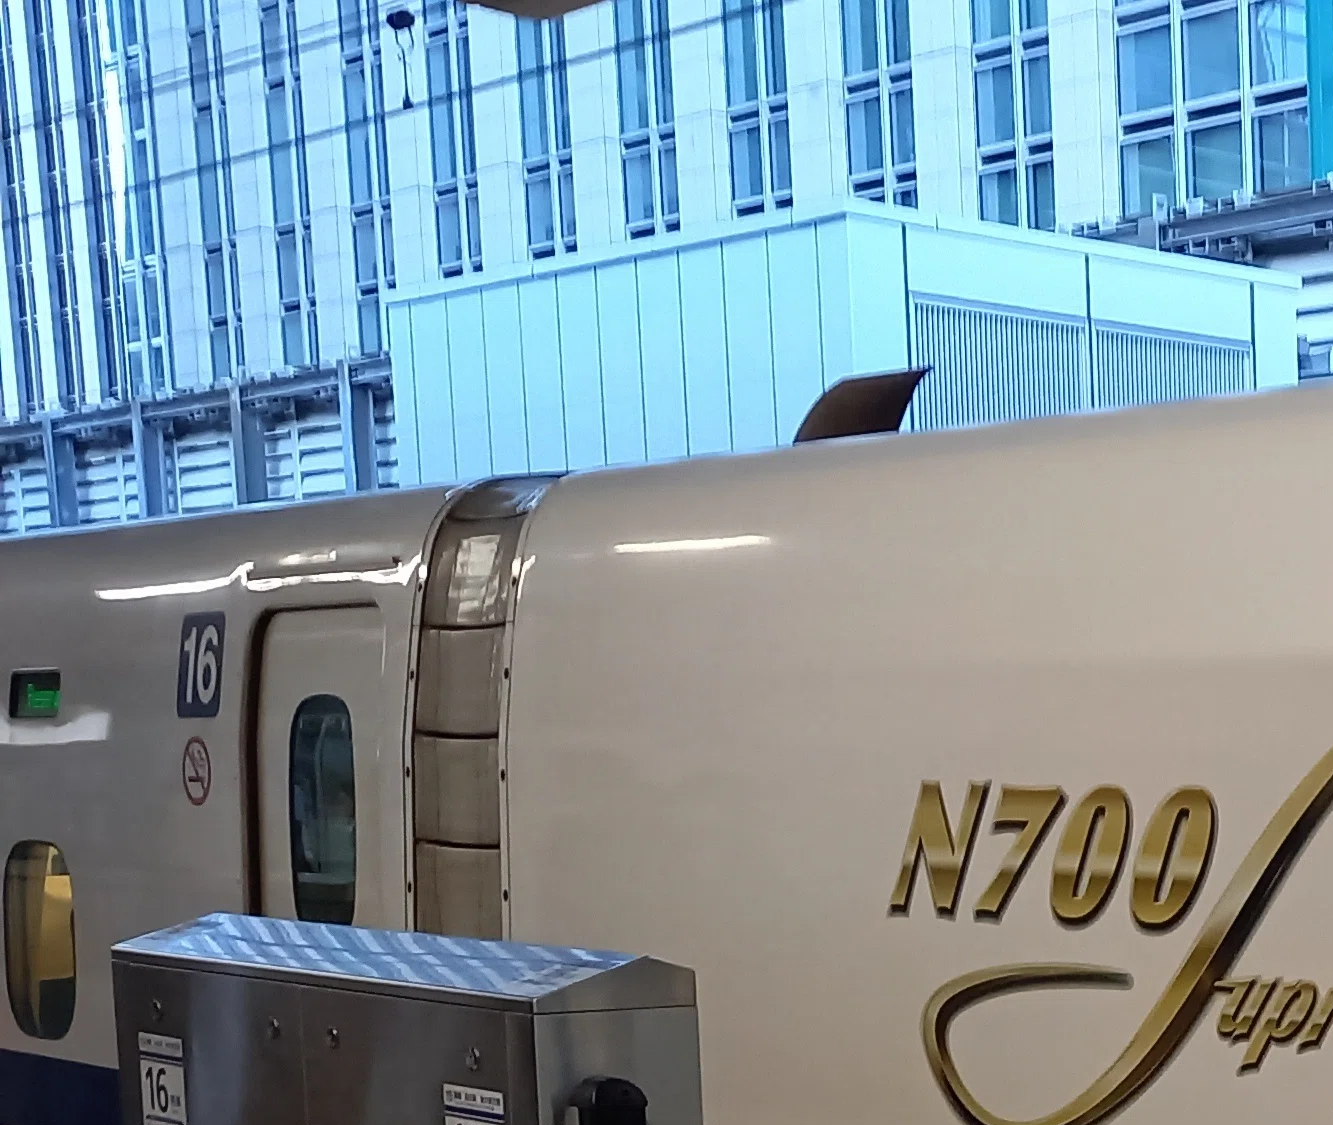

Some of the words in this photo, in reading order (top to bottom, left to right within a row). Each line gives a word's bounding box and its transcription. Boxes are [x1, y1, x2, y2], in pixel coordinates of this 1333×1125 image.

[183, 624, 219, 704] 16
[887, 778, 1218, 935] N700
[145, 1066, 169, 1113] 16
